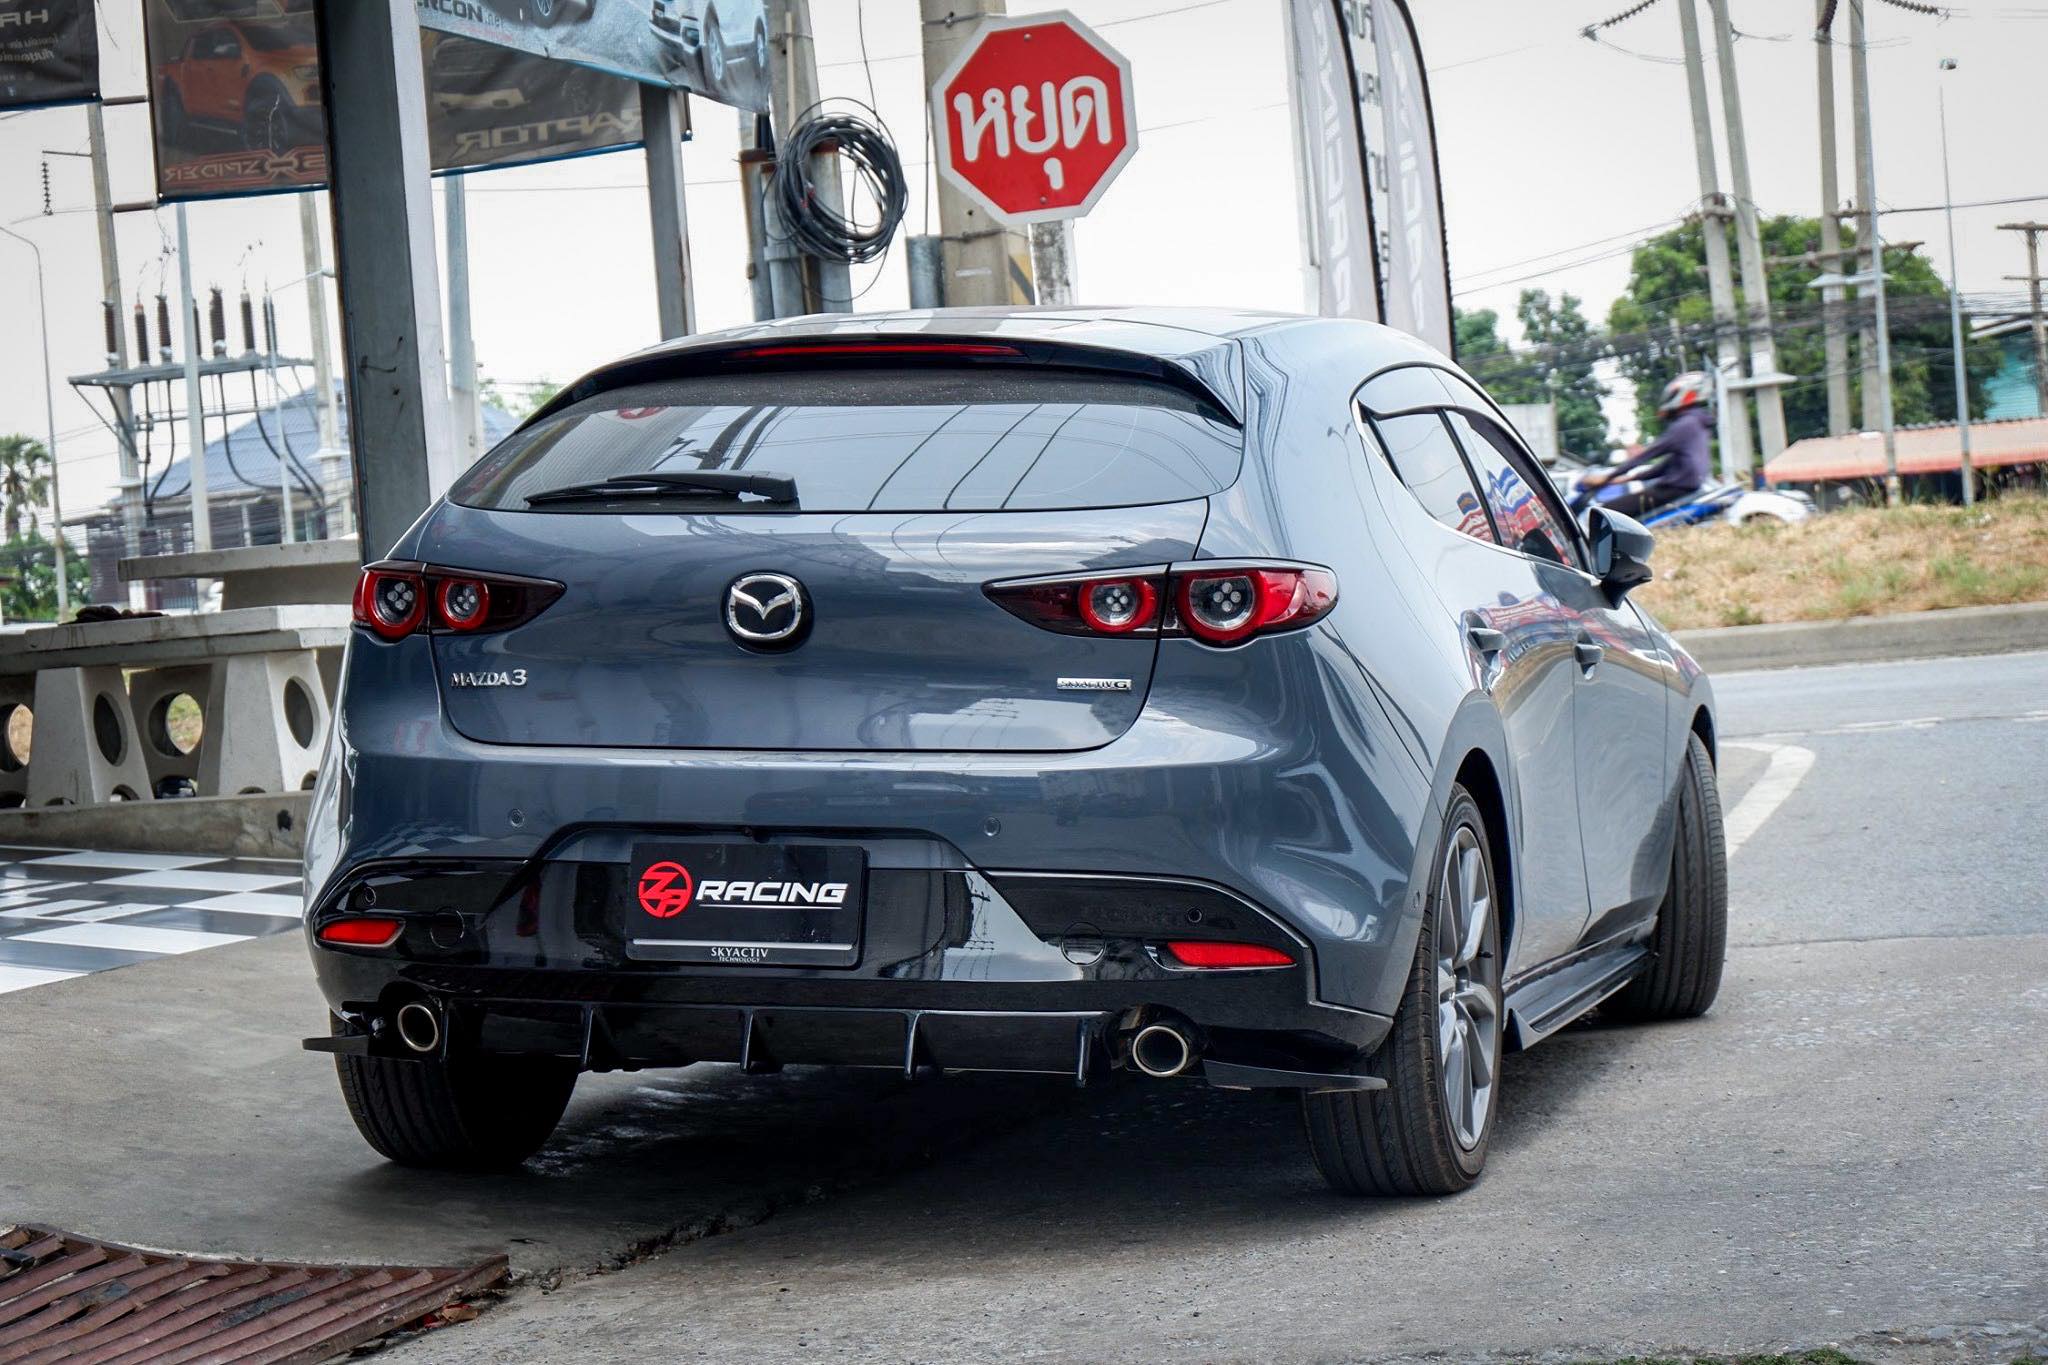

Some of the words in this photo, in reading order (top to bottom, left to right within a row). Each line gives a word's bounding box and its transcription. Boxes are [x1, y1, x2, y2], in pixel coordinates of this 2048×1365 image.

[953, 75, 1113, 190] หยุด
[696, 880, 849, 904] RACING
[711, 946, 769, 958] SKYACTIV
